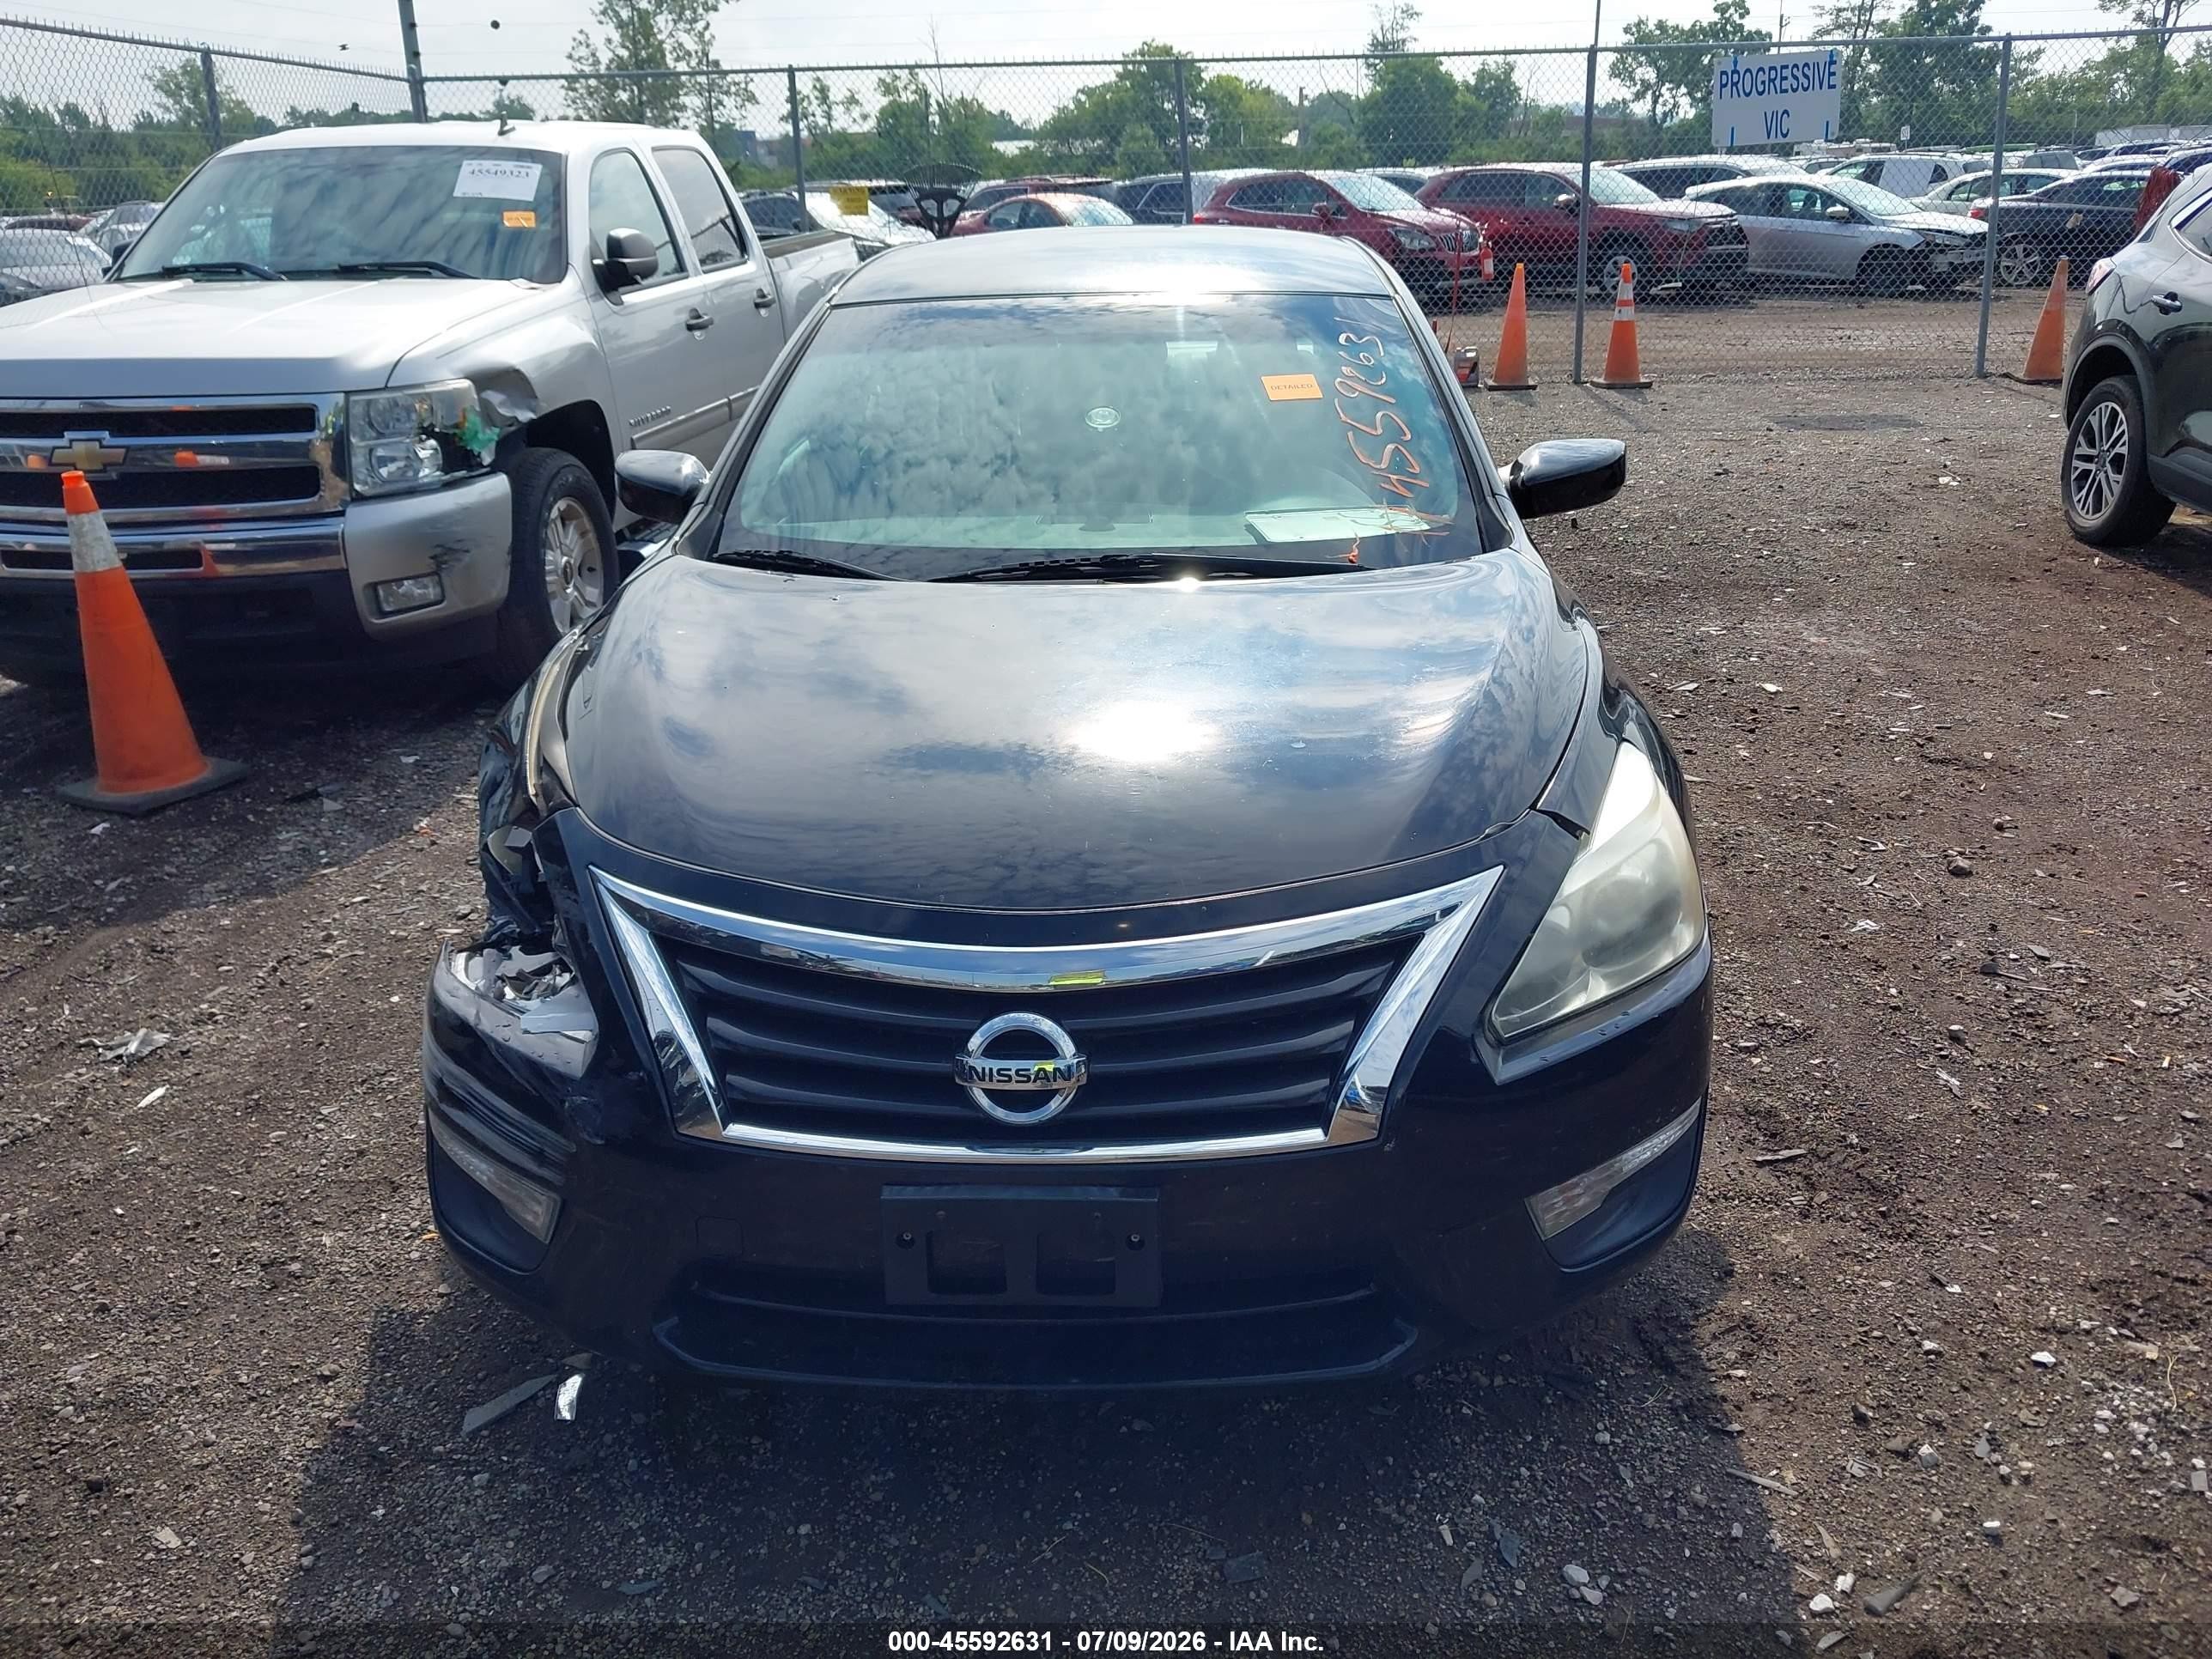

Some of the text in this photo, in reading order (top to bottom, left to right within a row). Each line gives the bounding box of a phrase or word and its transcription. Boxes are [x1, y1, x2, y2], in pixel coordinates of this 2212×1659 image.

[1720, 60, 1837, 99] PROGRESSIVE
[1764, 109, 1790, 138] VIC
[969, 1065, 1072, 1083] NISSAN
